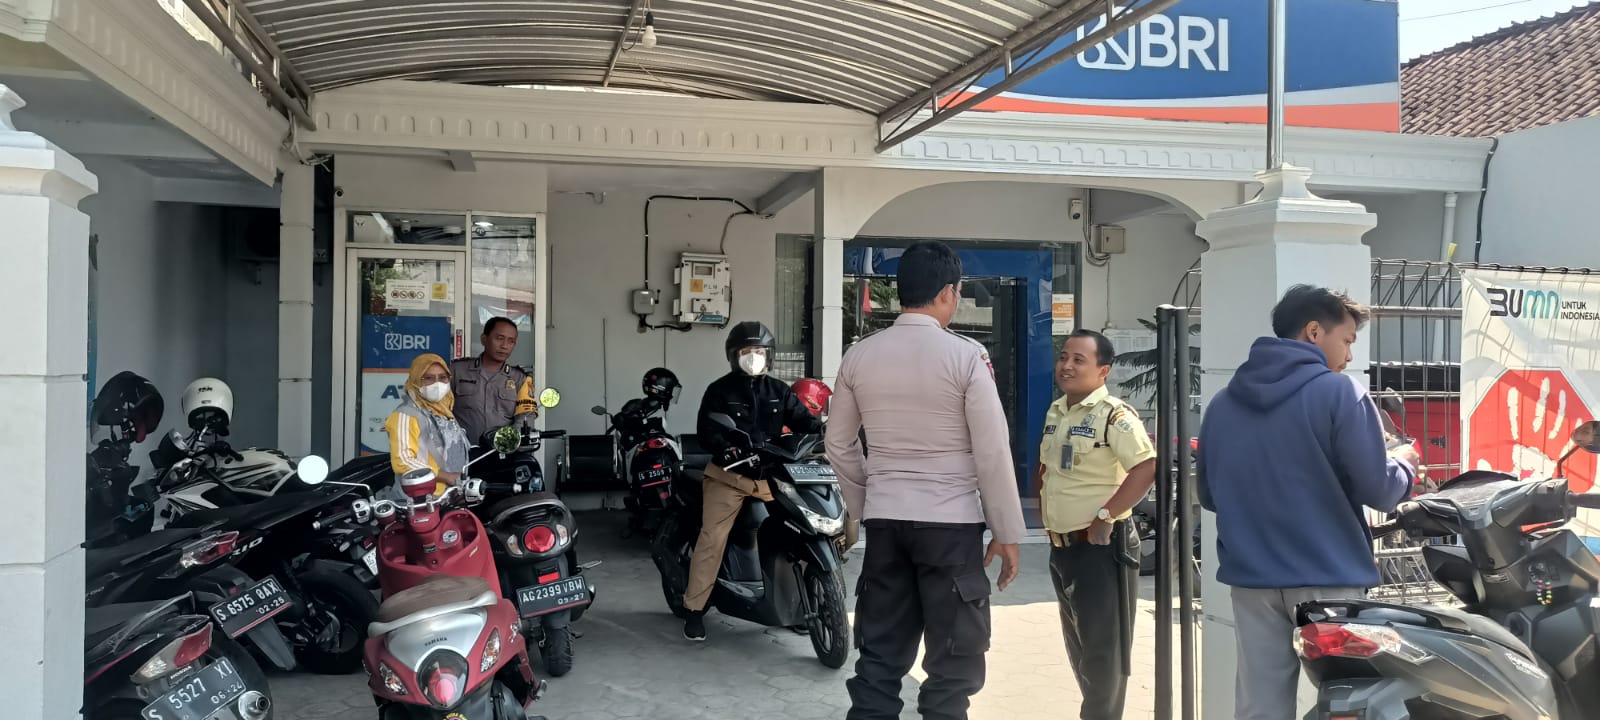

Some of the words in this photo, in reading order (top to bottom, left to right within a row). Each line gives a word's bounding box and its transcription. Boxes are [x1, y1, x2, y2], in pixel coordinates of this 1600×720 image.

[1140, 14, 1229, 71] BRI
[1487, 288, 1560, 318] BUMN
[1560, 312, 1600, 320] INDONESIA
[1562, 301, 1587, 310] UNTUK
[403, 334, 430, 350] BRI
[216, 609, 227, 620] S
[227, 594, 255, 615] 6575
[148, 708, 163, 720] S
[168, 677, 207, 709] 5527
[214, 660, 232, 679] XI
